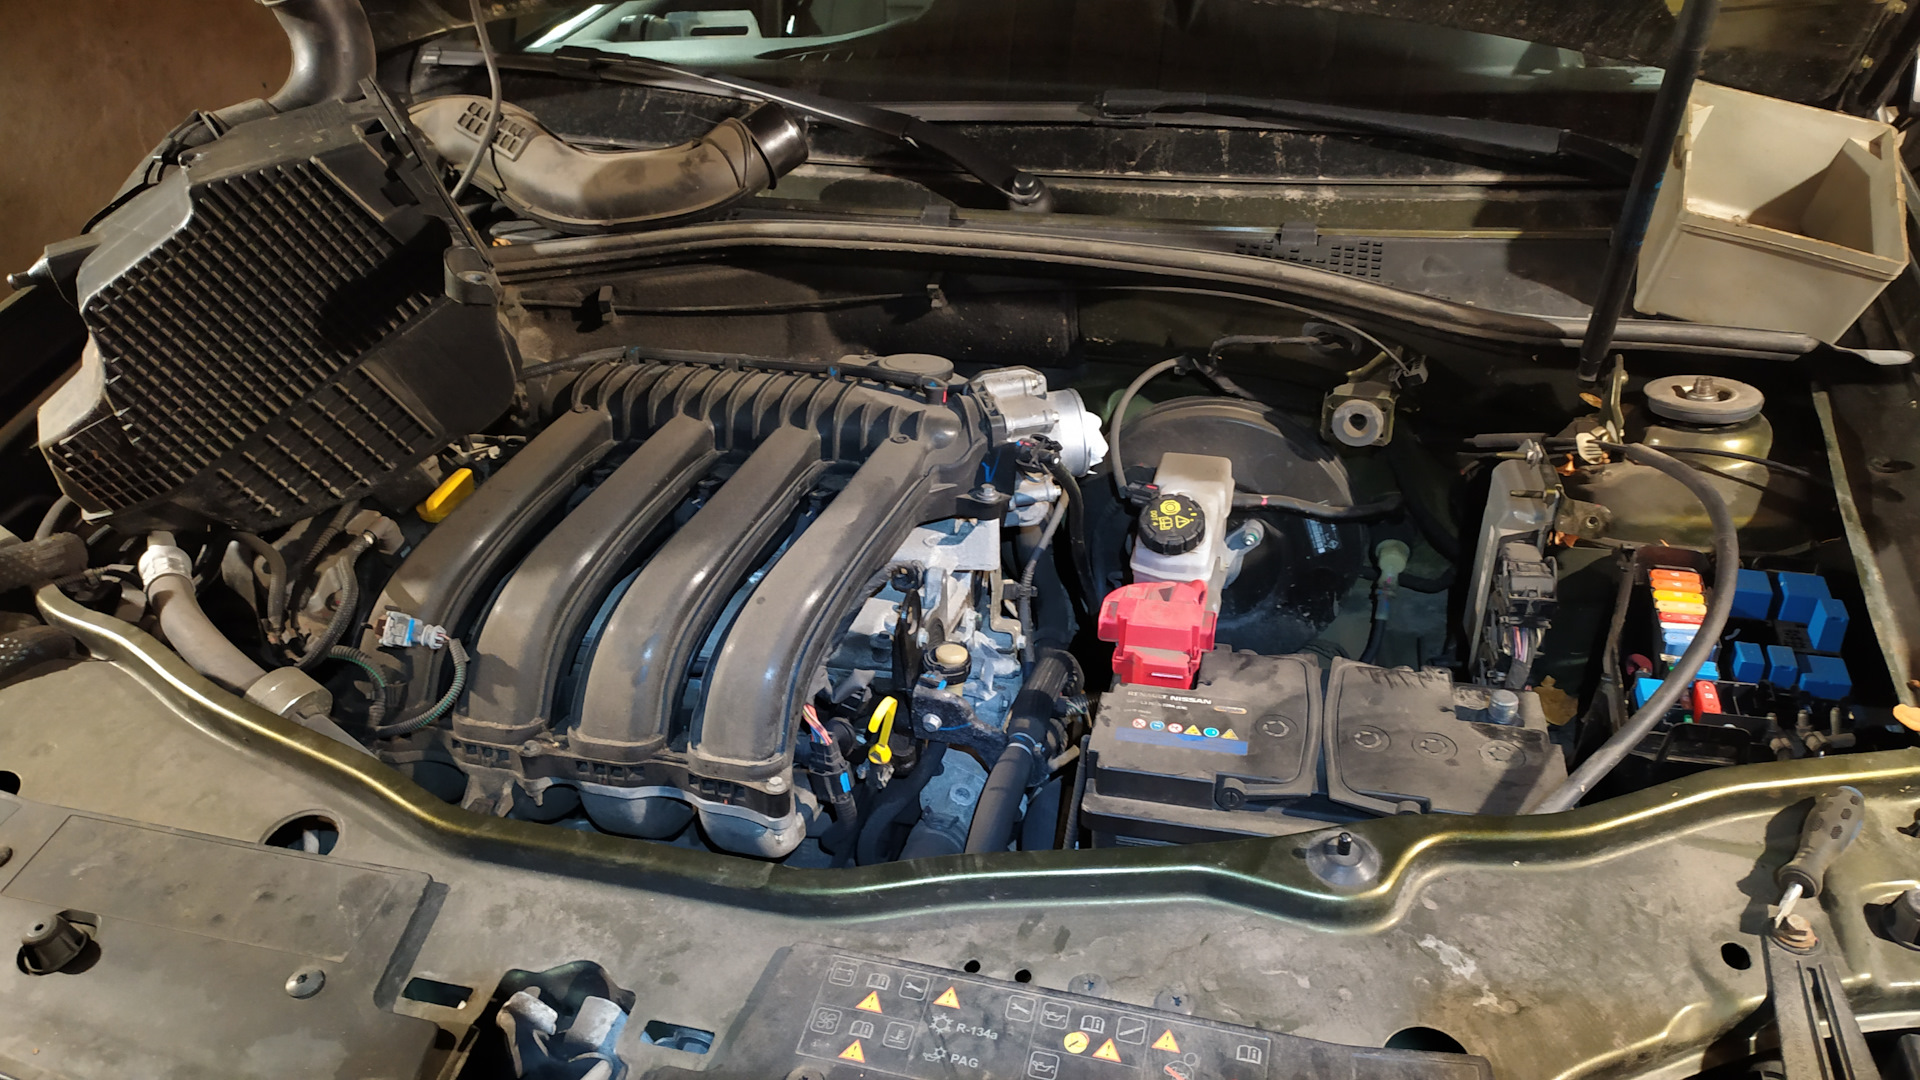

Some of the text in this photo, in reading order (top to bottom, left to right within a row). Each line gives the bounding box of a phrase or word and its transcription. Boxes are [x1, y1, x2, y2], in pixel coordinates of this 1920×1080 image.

[1150, 510, 1158, 521] DOT
[1169, 694, 1212, 705] NISSAN
[956, 1022, 998, 1040] R-134a
[950, 1053, 979, 1068] PAG
